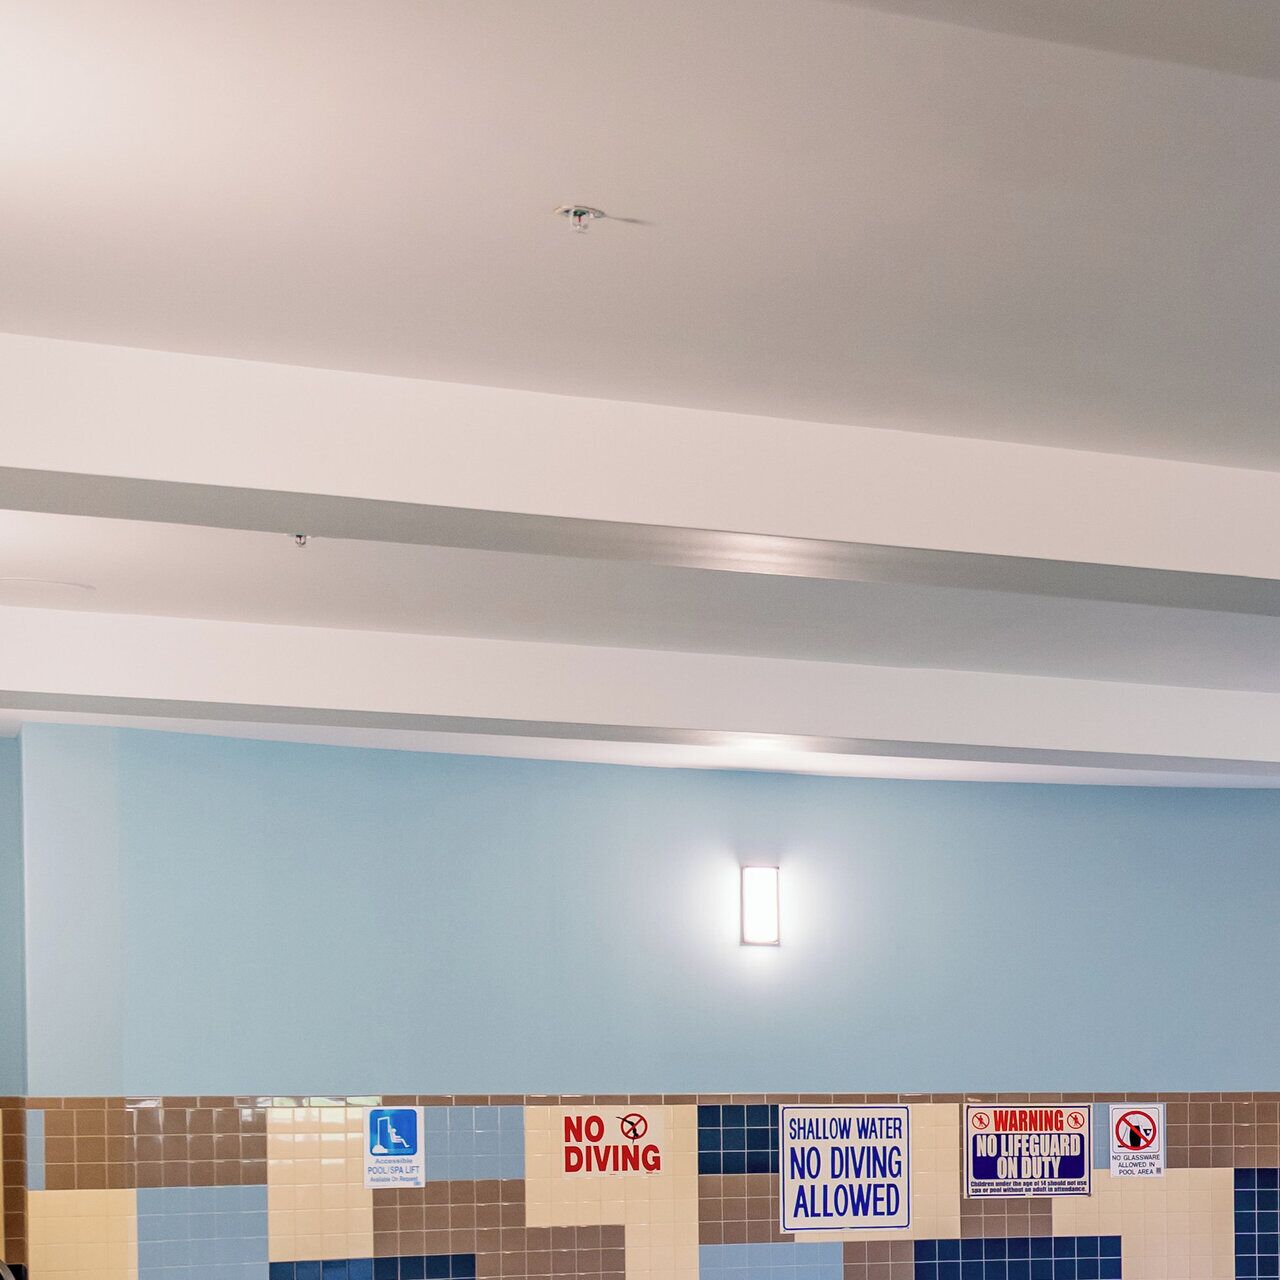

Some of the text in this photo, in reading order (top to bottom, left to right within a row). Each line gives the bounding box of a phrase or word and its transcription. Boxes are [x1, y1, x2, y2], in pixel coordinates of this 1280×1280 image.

[564, 1115, 604, 1142] NO
[789, 1117, 902, 1140] SHALLOW WATER
[993, 1110, 1064, 1132] WARNING
[564, 1144, 661, 1172] DIVING
[976, 1134, 1081, 1157] NO LIFEGUARD
[790, 1146, 902, 1179] NO DIVING
[997, 1156, 1061, 1179] ON DUTY
[793, 1184, 900, 1217] ALLOWED
